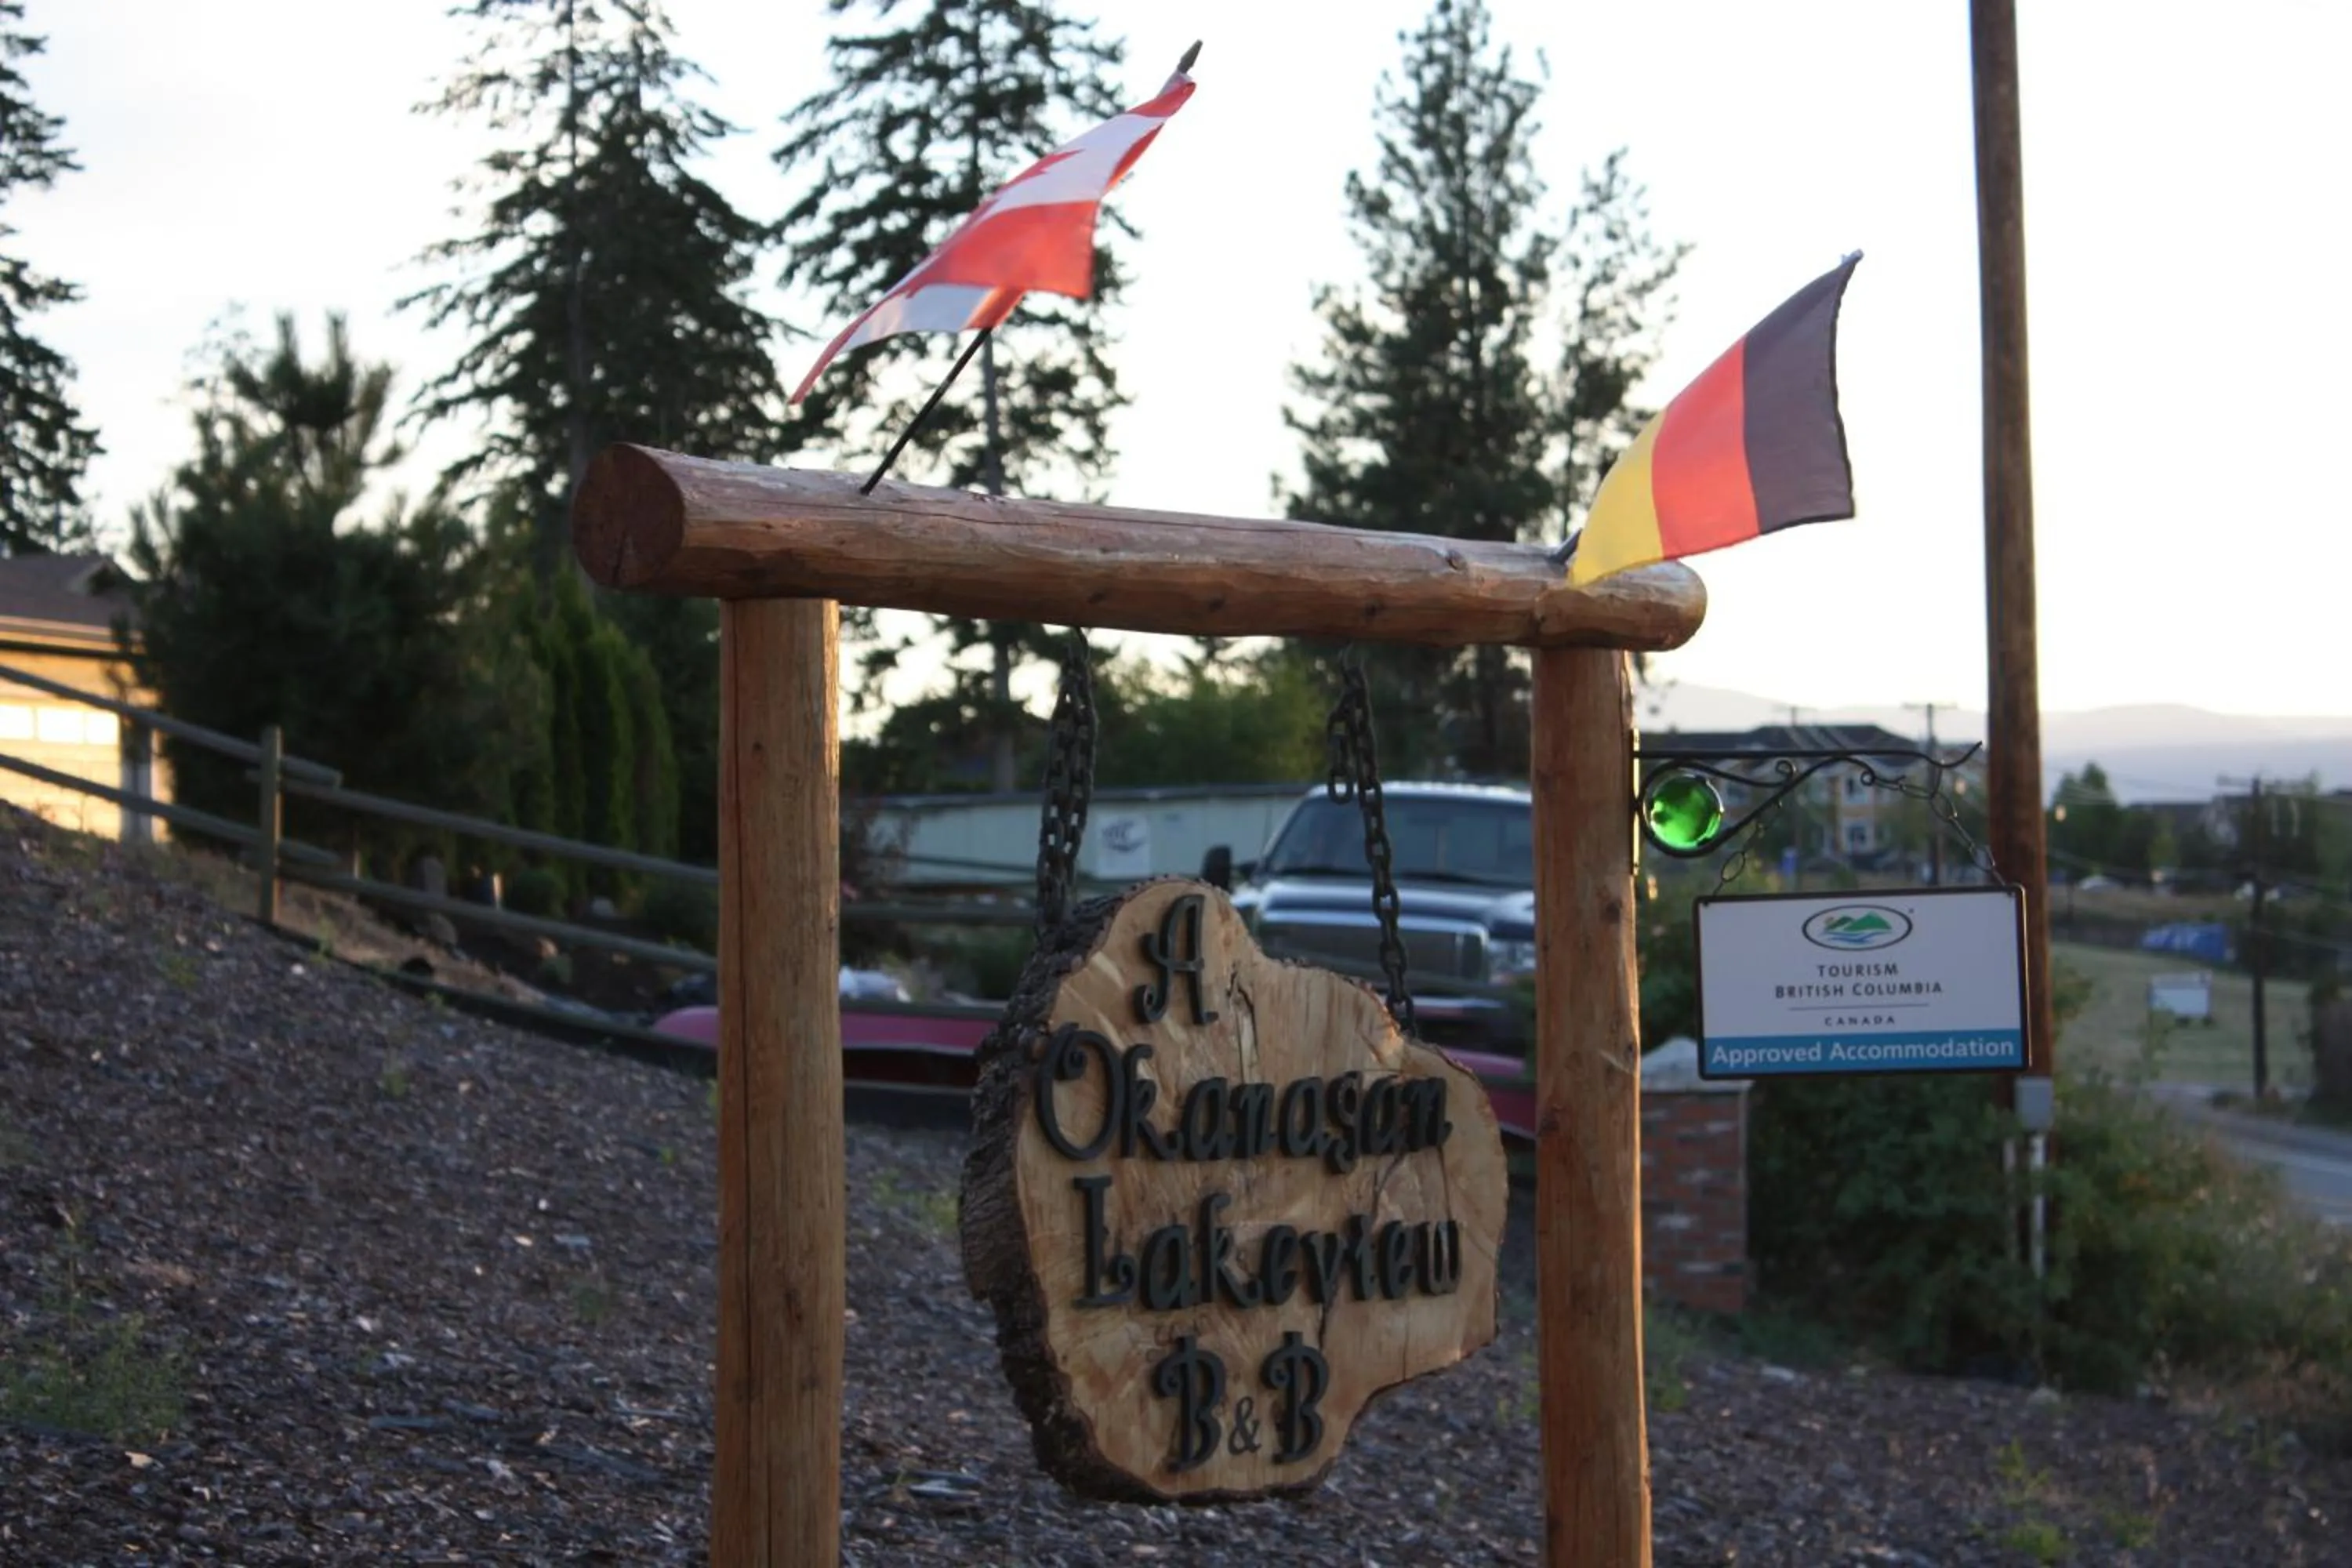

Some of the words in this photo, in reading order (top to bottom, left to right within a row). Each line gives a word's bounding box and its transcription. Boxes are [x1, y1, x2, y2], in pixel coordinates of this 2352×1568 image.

[1133, 894, 1218, 1025] A
[1817, 962, 1899, 978] TOURISM
[1775, 984, 1844, 999] BRITISH
[1852, 982, 1943, 996] COLUMBIA
[1824, 1015, 1896, 1027] CANADA
[1711, 1042, 1822, 1067] Approved
[1830, 1036, 2014, 1061] Accommodation
[1034, 1022, 1453, 1175] Okanagan
[1072, 1174, 1463, 1310] Lakeview
